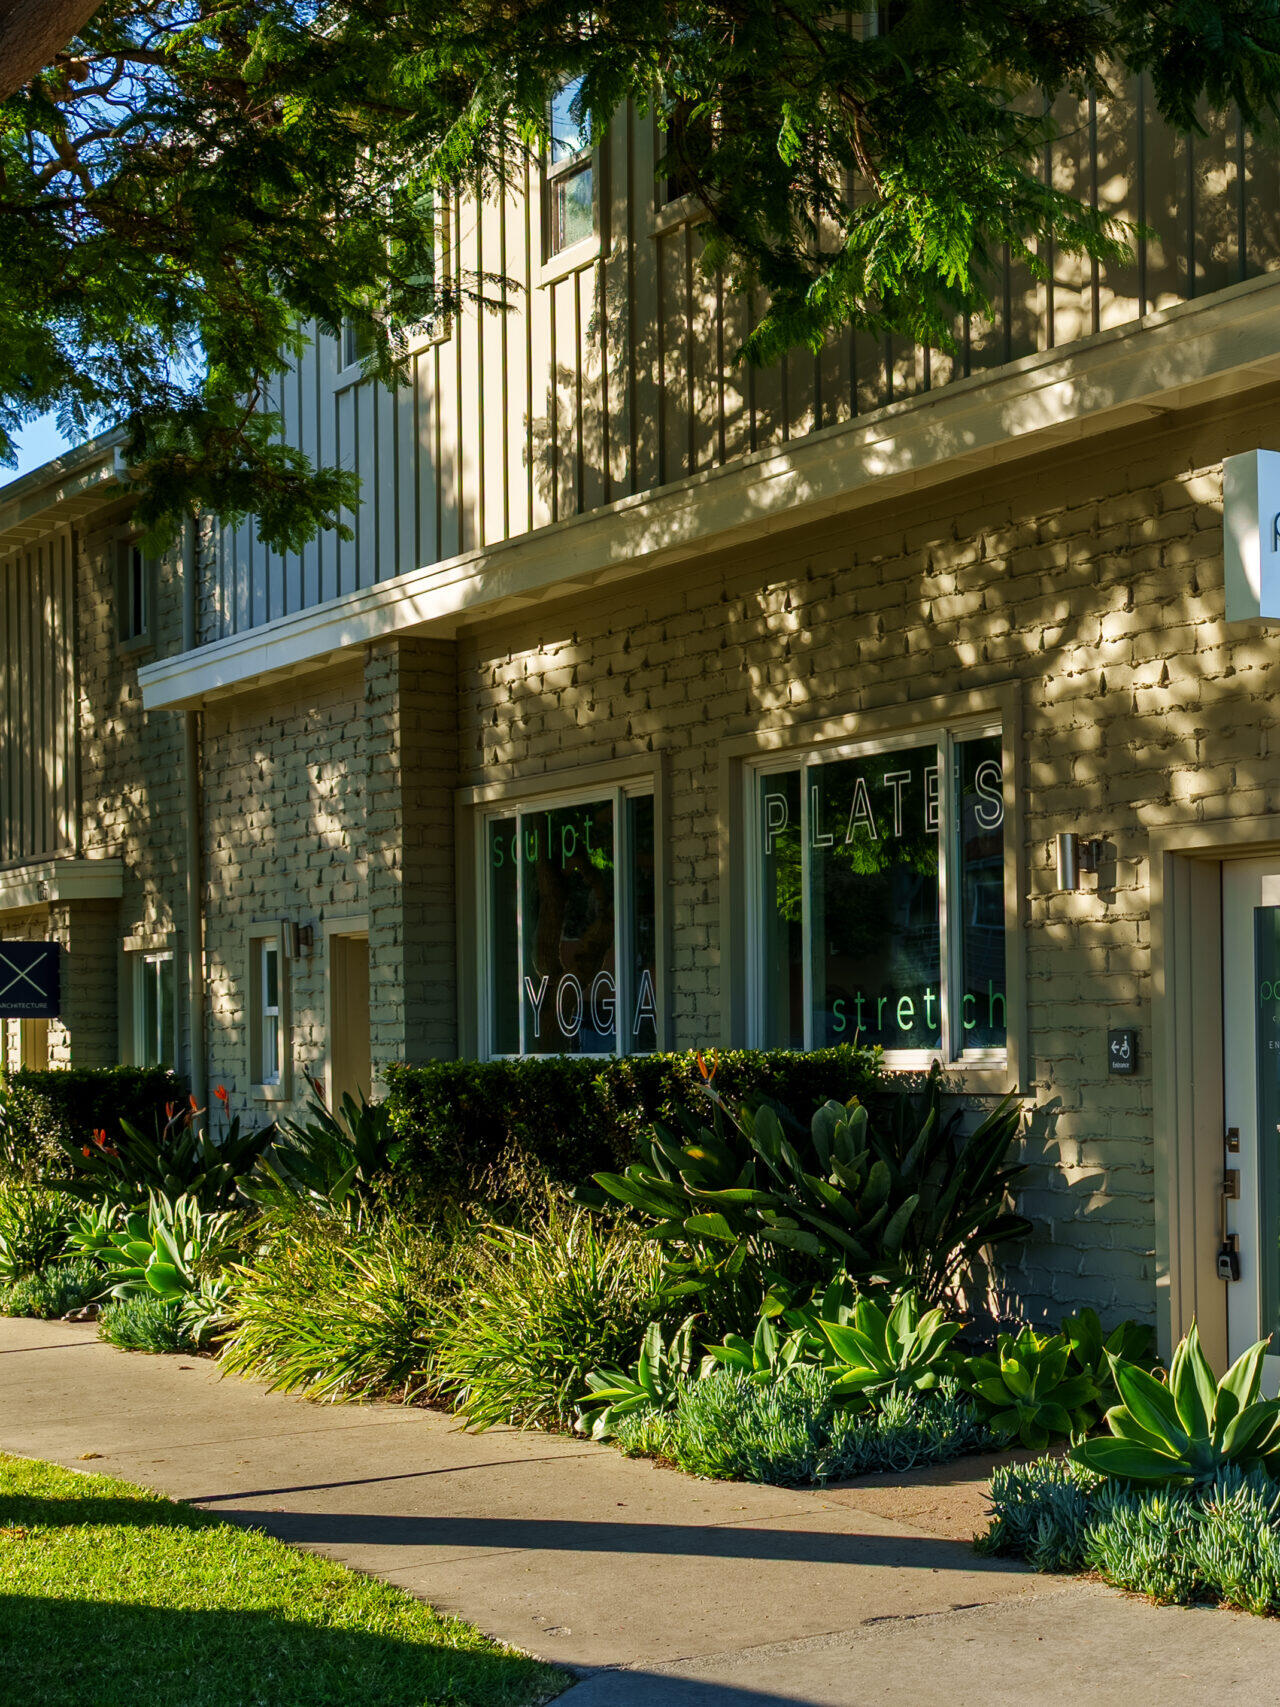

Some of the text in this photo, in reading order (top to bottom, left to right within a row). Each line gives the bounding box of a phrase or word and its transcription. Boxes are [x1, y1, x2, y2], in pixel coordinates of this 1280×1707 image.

[764, 760, 1004, 855] PLATES
[493, 814, 594, 869] sculpt
[524, 970, 658, 1037] YOGA
[832, 980, 1007, 1032] stretch
